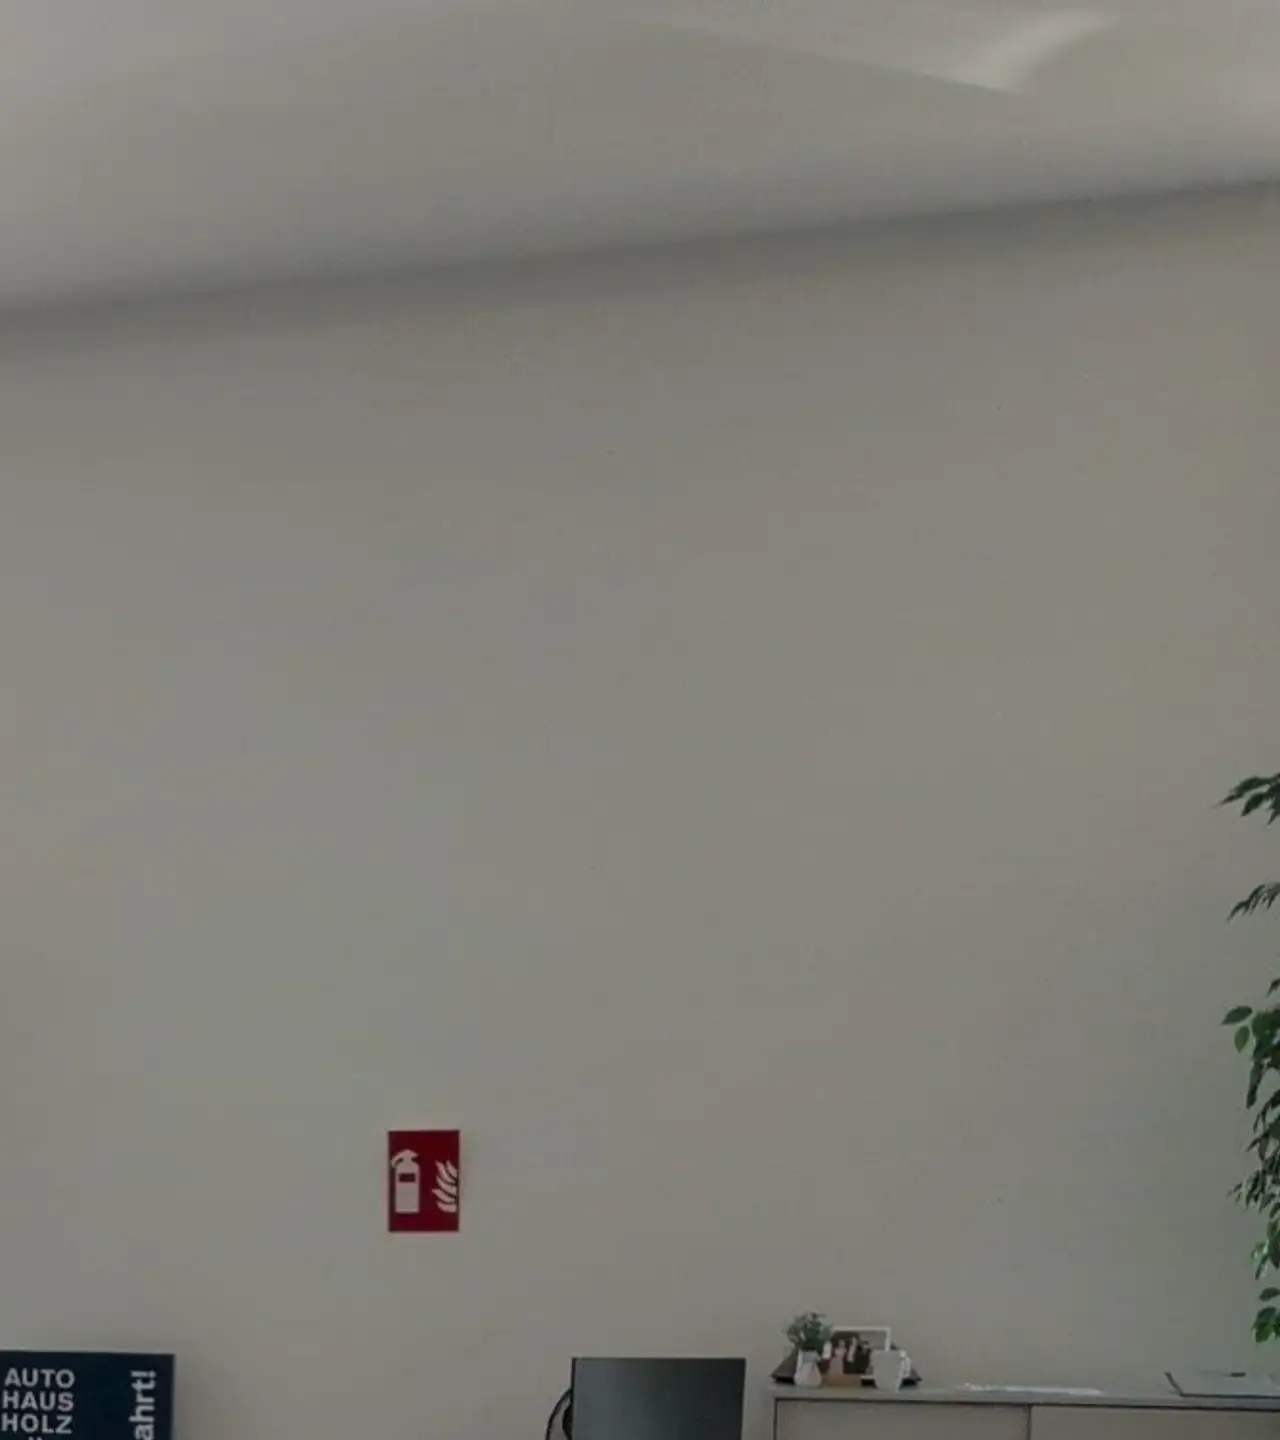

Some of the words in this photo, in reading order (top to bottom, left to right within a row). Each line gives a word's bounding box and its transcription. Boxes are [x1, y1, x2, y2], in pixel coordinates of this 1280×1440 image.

[3, 1367, 76, 1389] AUTO
[1, 1389, 75, 1412] HAUS
[0, 1412, 73, 1435] HOLZ
